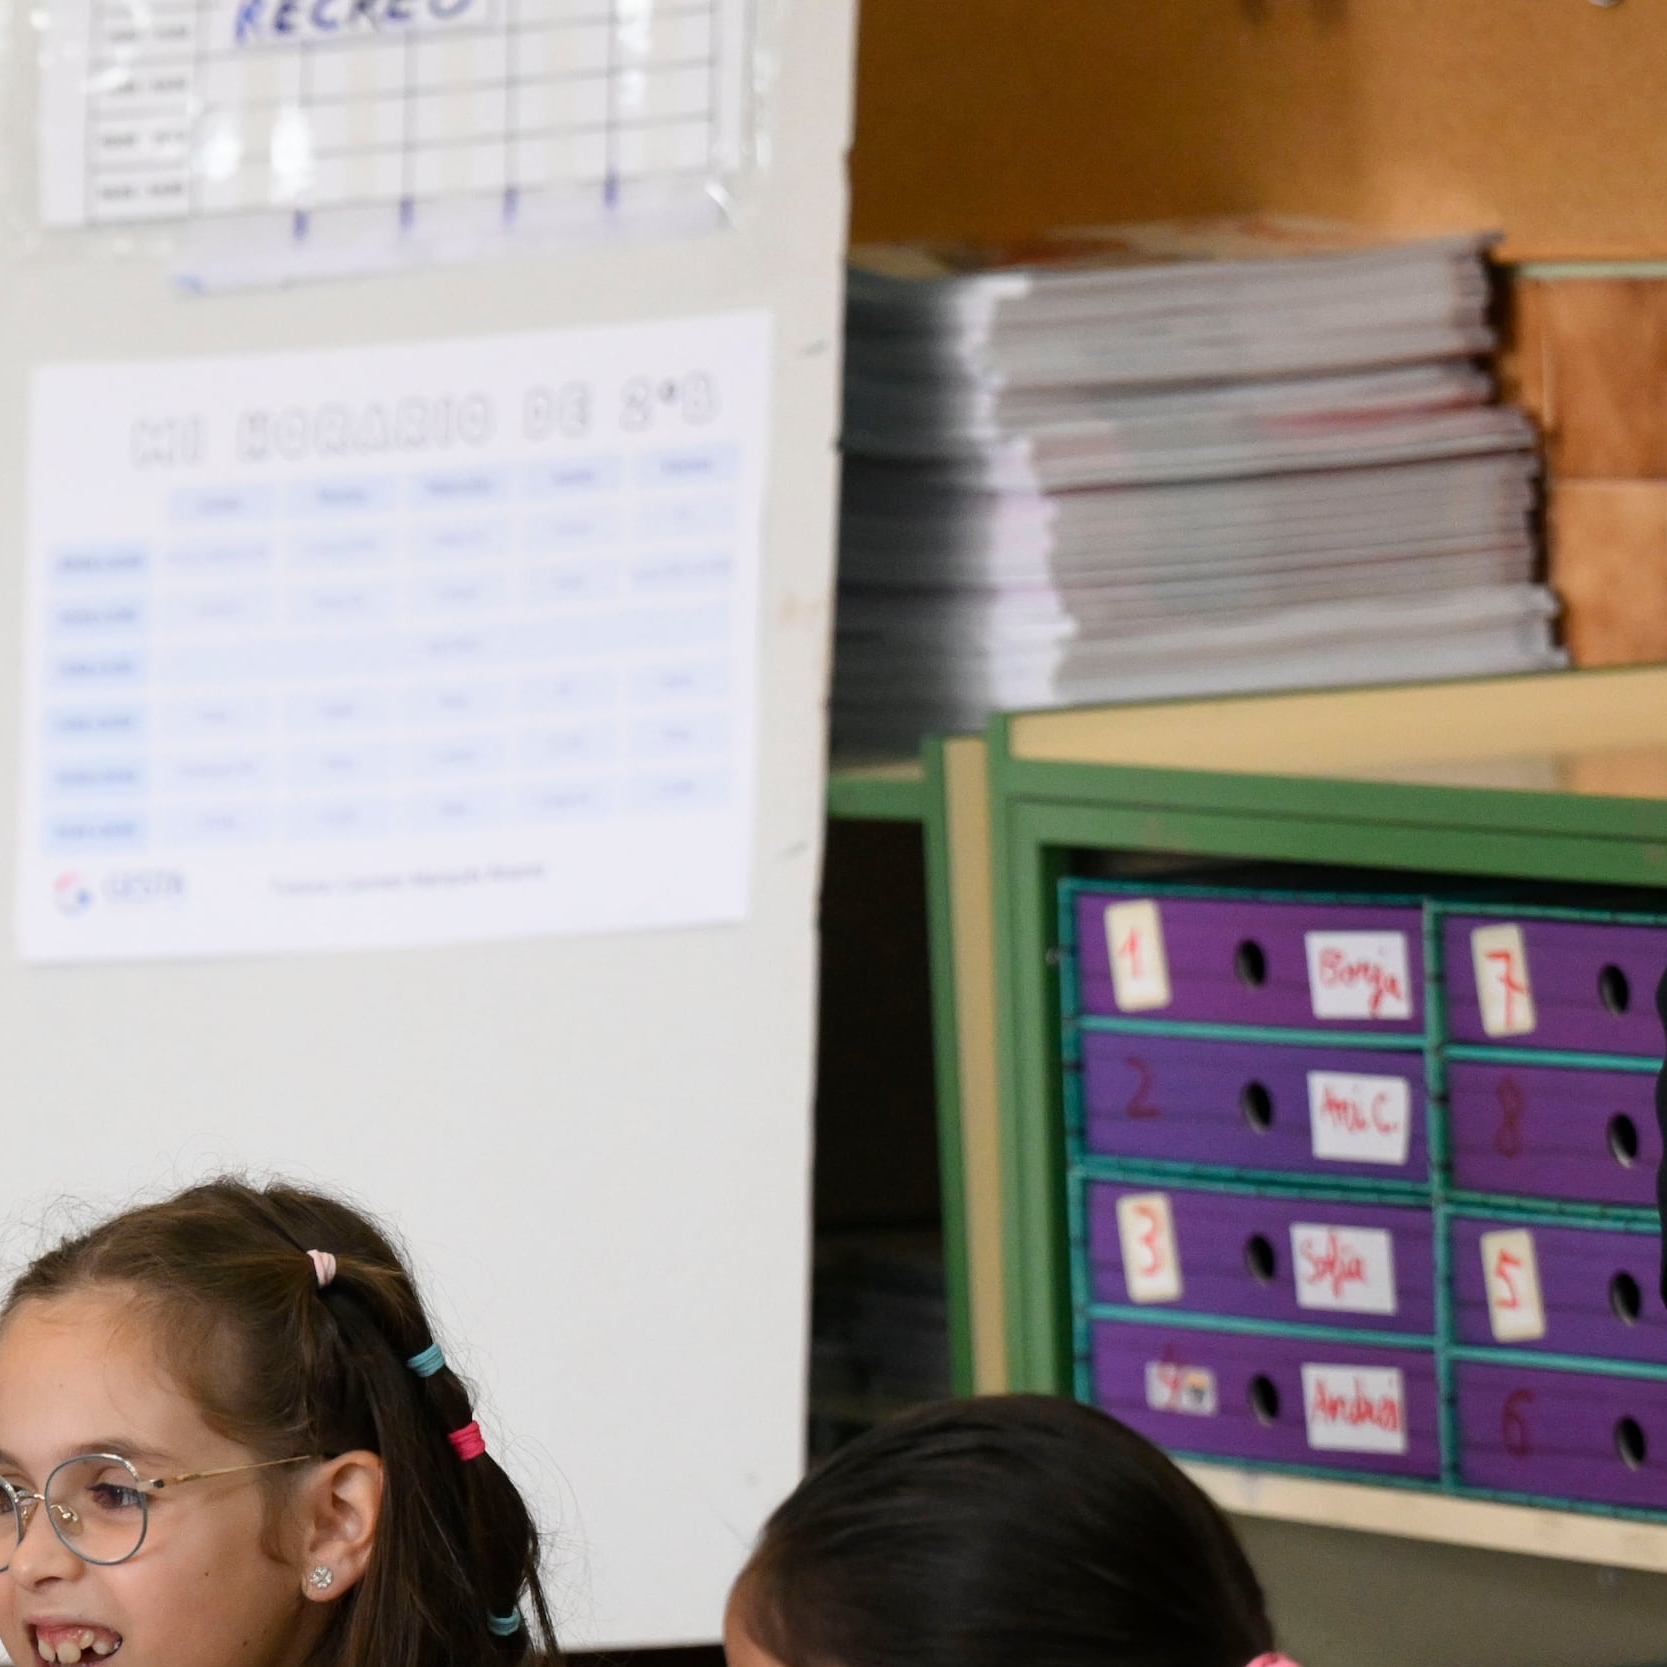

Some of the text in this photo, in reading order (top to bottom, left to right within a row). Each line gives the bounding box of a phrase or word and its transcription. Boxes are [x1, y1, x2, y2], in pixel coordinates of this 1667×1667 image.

[1118, 926, 1145, 981] 1
[1484, 950, 1530, 1031] 7
[1124, 1053, 1163, 1121] 2
[1493, 1073, 1525, 1160] 8
[1133, 1202, 1164, 1279] 3
[1493, 1247, 1524, 1311] 5
[1500, 1388, 1535, 1460] 6
